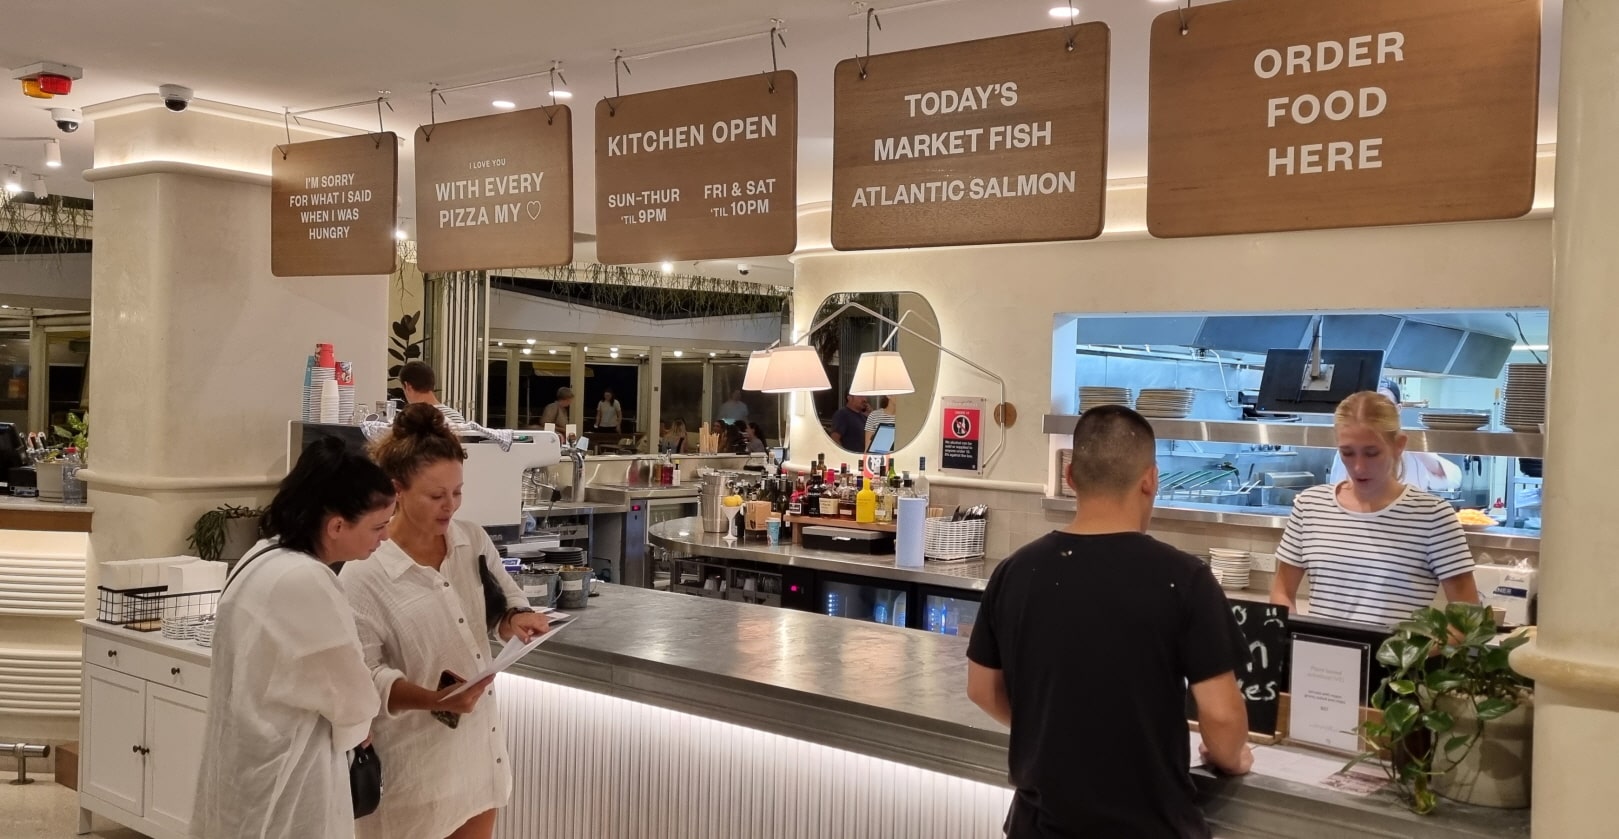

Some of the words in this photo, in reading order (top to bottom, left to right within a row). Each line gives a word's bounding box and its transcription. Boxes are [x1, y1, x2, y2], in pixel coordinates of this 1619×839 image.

[1254, 32, 1405, 80] ORDER
[904, 82, 1018, 118] TODAY'S
[1267, 87, 1388, 128] FOOD
[608, 124, 705, 157] KITCHEN
[712, 114, 777, 144] OPEN
[874, 128, 984, 162] MARKET
[990, 121, 1052, 151] FISH
[473, 160, 490, 169] LOVE
[492, 158, 506, 167] YOU
[1268, 138, 1383, 177] HERE
[305, 175, 319, 189] I'M
[321, 173, 355, 188] SORRY
[435, 180, 480, 202] WITH
[485, 172, 545, 197] EVERY
[705, 183, 727, 200] FRI
[730, 182, 743, 197] &
[745, 179, 777, 196] SAT
[851, 179, 966, 209] ATLANTIC
[968, 171, 1076, 200] SALMON
[290, 194, 309, 208] FOR
[311, 192, 340, 206] WHAT
[341, 191, 345, 204] I
[347, 190, 372, 204] SAID
[730, 199, 770, 216] 10PM
[301, 210, 329, 224] WHEN
[331, 210, 335, 223] I
[336, 208, 360, 222] WAS
[439, 204, 490, 229] PIZZA
[494, 201, 522, 224] MY
[639, 208, 667, 224] 9PM
[308, 226, 351, 241] HUNGRY
